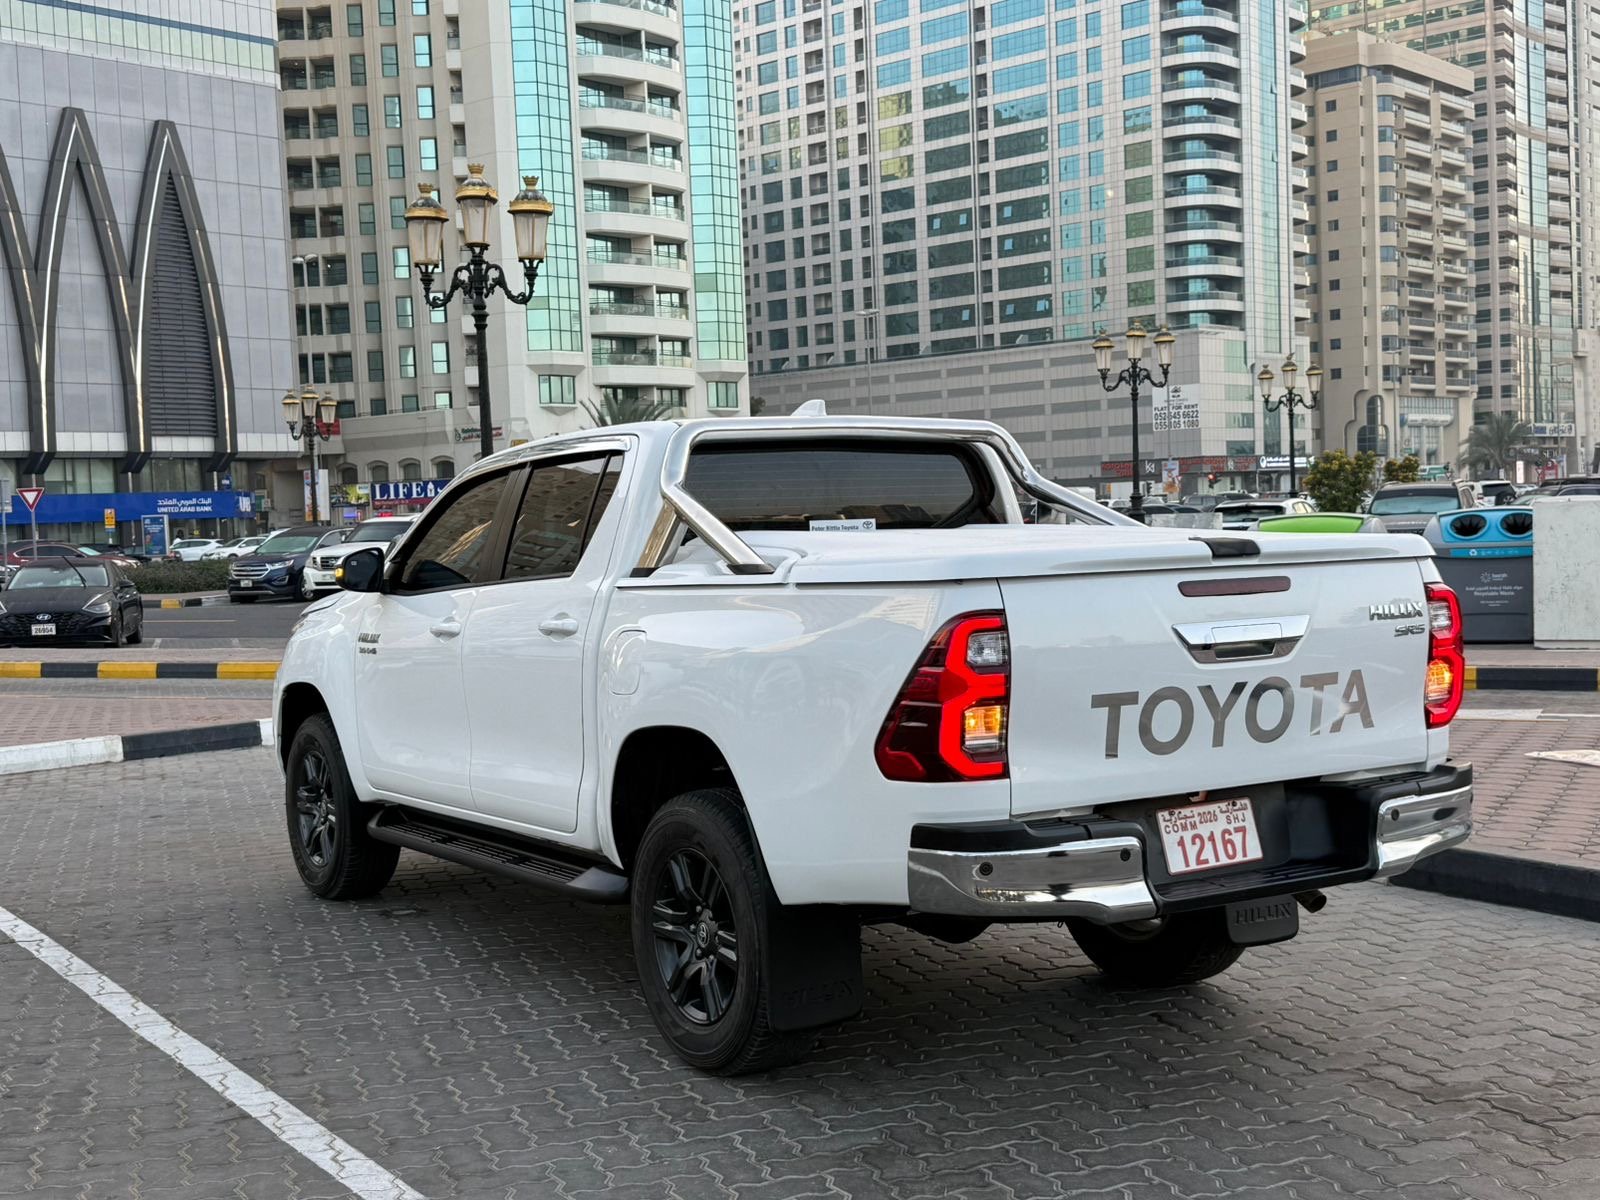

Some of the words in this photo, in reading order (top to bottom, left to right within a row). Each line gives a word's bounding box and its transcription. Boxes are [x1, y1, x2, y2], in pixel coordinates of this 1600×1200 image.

[374, 481, 424, 500] LIFE
[1369, 602, 1423, 621] HILUX
[1091, 669, 1374, 760] TOYOTA
[1197, 810, 1218, 824] 2026
[1225, 812, 1246, 824] SHJ
[1164, 820, 1198, 834] COMM
[1177, 825, 1248, 868] 12167
